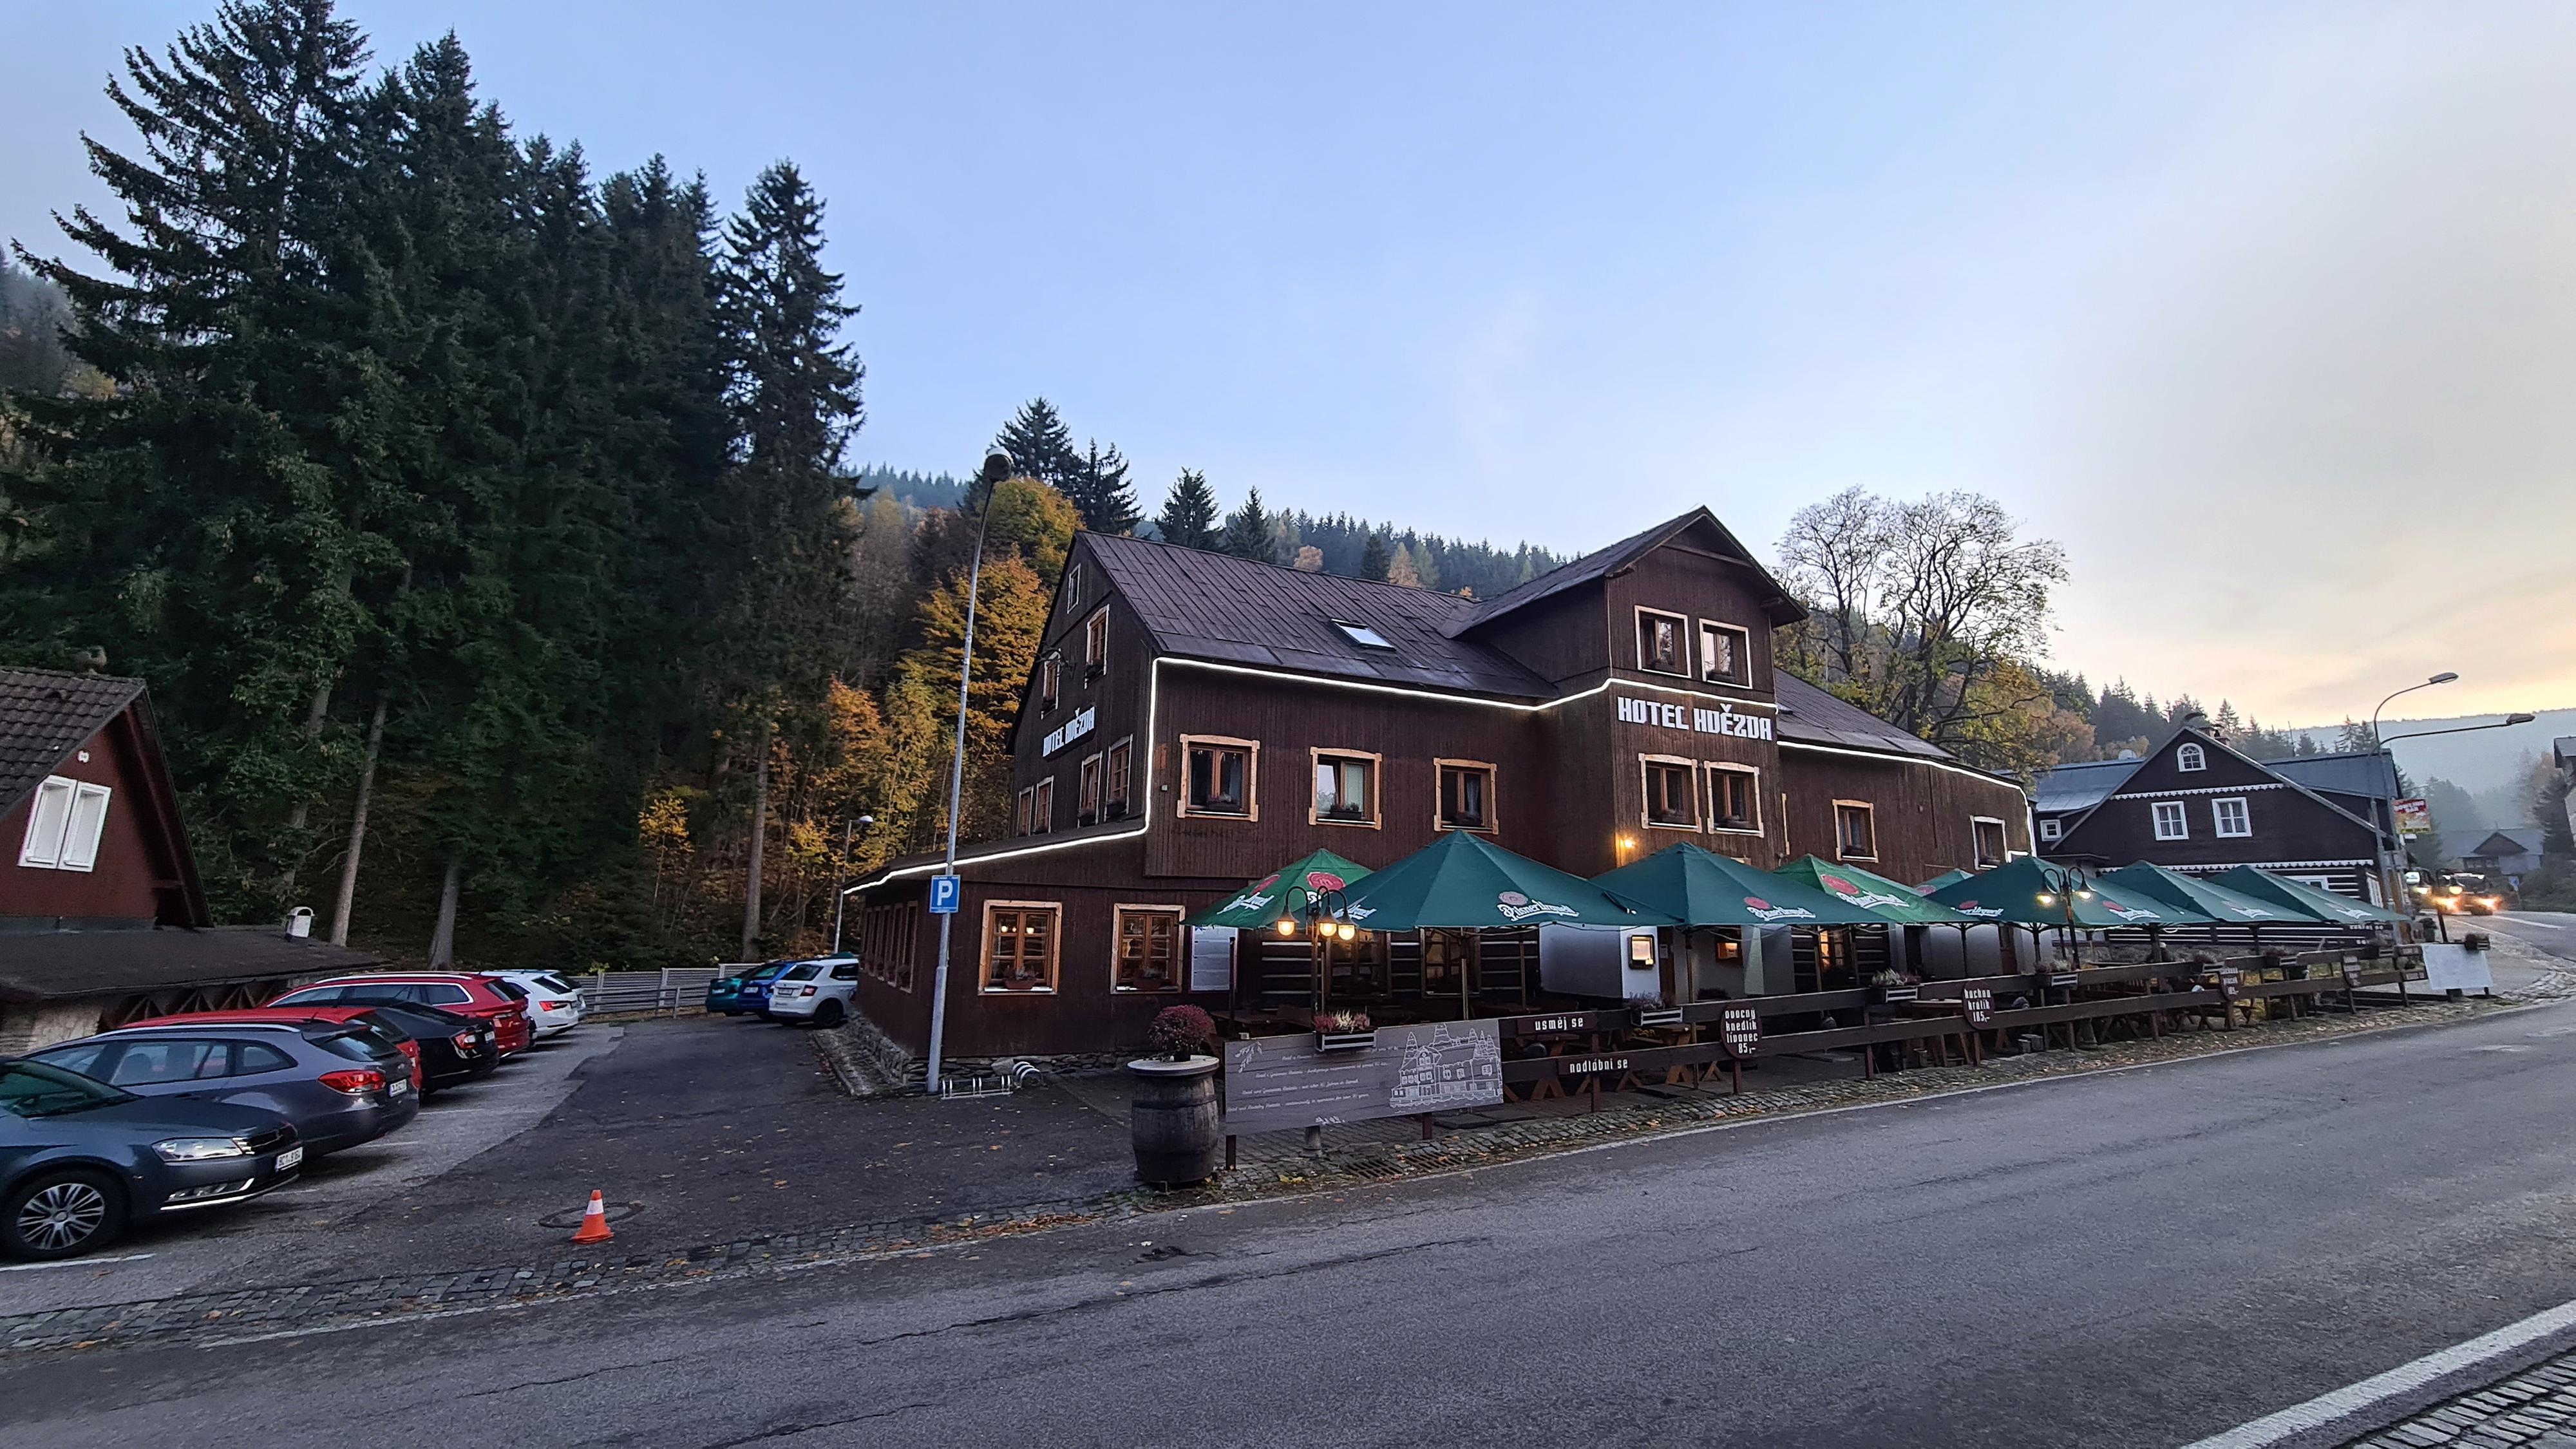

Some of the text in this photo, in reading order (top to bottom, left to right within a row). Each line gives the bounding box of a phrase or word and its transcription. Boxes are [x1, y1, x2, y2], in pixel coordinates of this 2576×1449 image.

[1617, 697, 1689, 730] HOTEL
[937, 880, 953, 906] P
[1535, 1017, 1584, 1031] usměj se
[1725, 1019, 1757, 1032] knedlík
[1727, 1032, 1758, 1043] lívanec
[1617, 1059, 1628, 1069] se
